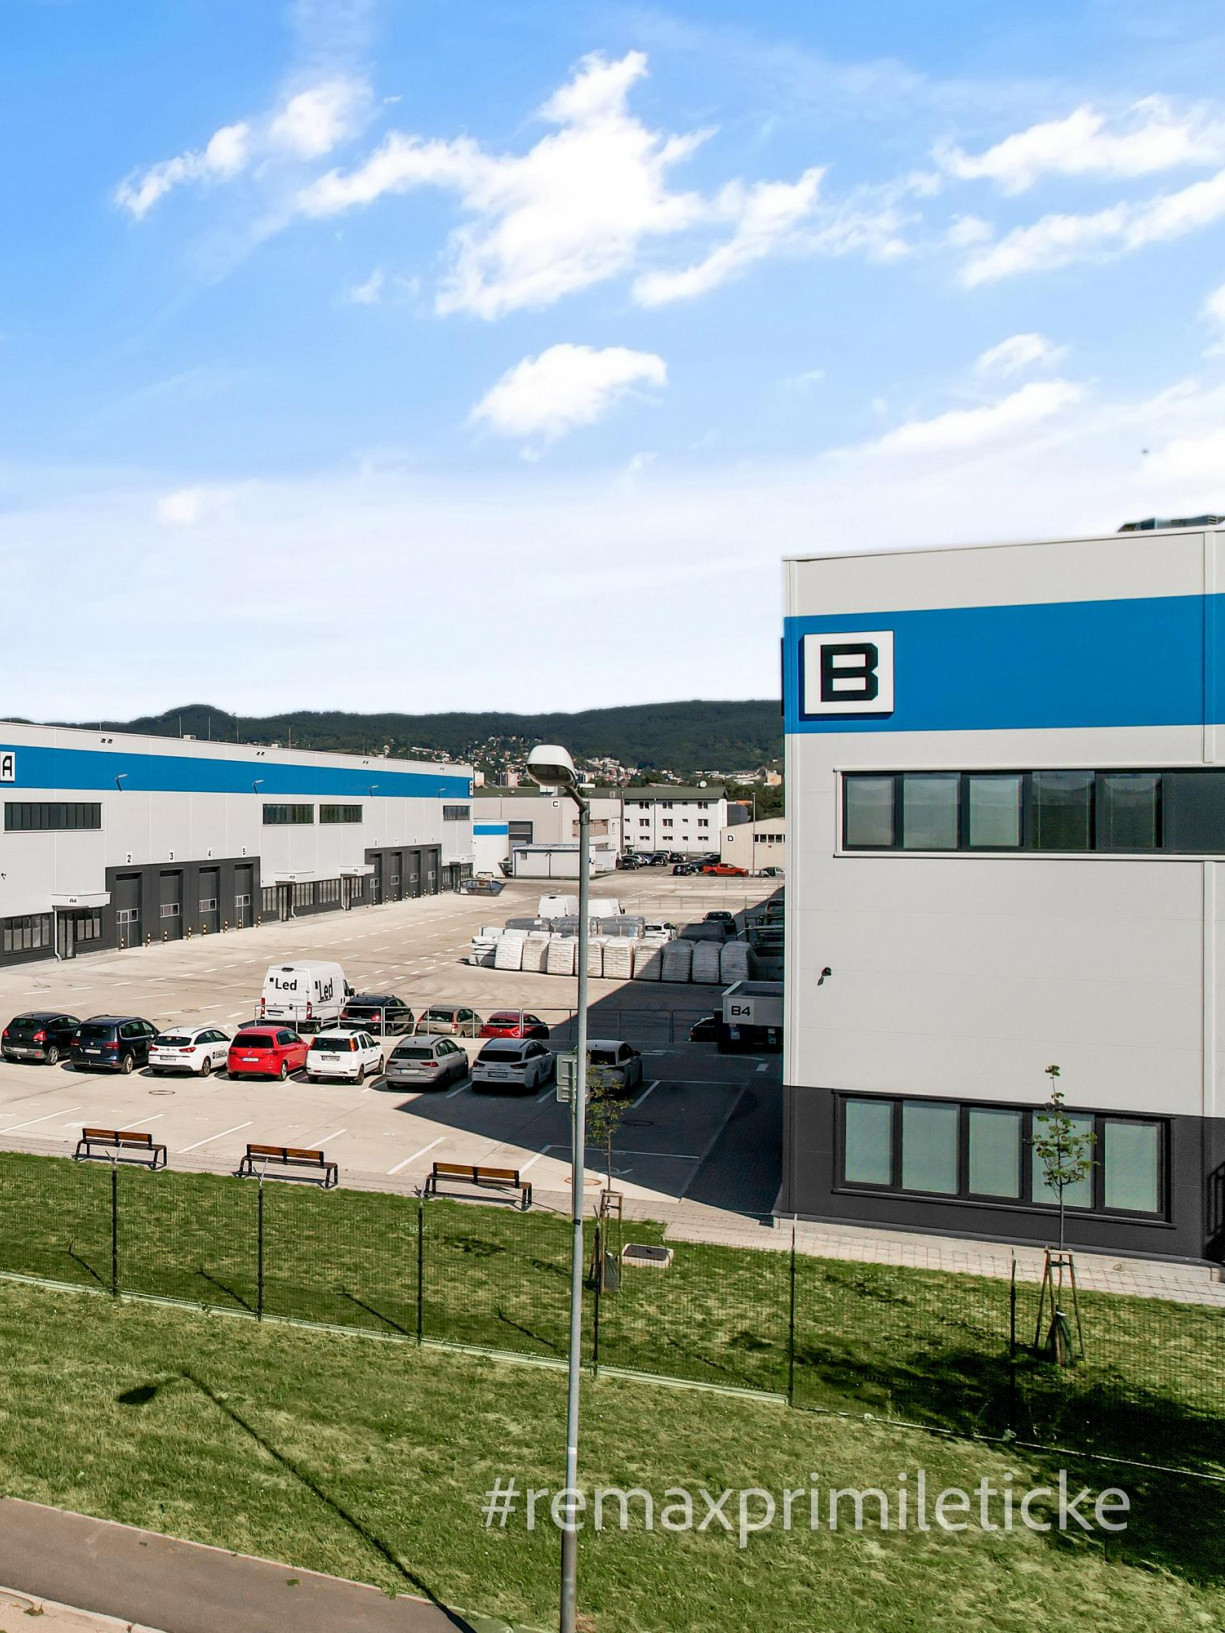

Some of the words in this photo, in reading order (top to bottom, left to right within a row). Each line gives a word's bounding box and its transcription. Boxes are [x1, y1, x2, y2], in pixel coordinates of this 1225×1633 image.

[820, 642, 878, 702] B
[2, 755, 12, 777] A
[275, 977, 298, 991] Led
[318, 978, 334, 1001] Led
[731, 1005, 751, 1017] B4
